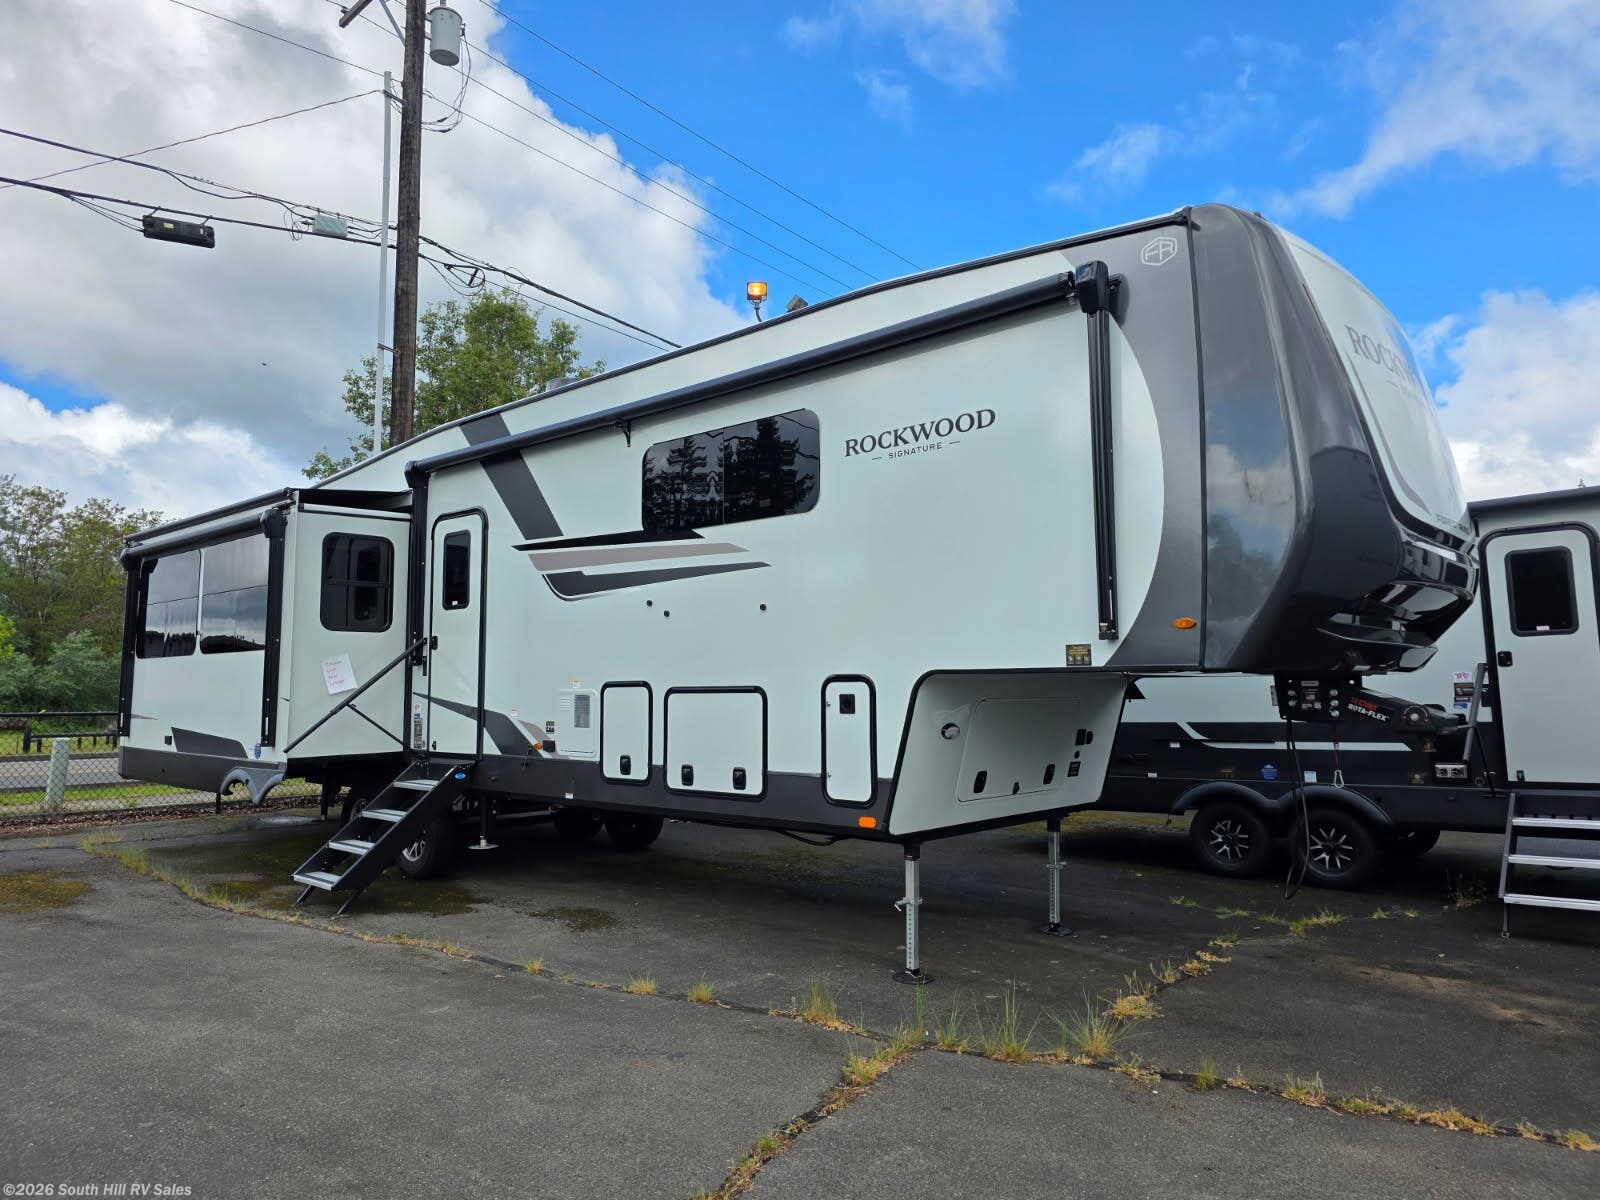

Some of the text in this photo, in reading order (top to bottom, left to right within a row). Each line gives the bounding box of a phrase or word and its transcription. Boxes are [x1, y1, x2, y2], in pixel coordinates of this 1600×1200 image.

[1344, 323, 1419, 389] ROCK
[844, 408, 996, 457] ROCKWOOD
[888, 441, 943, 459] SIGNATURE
